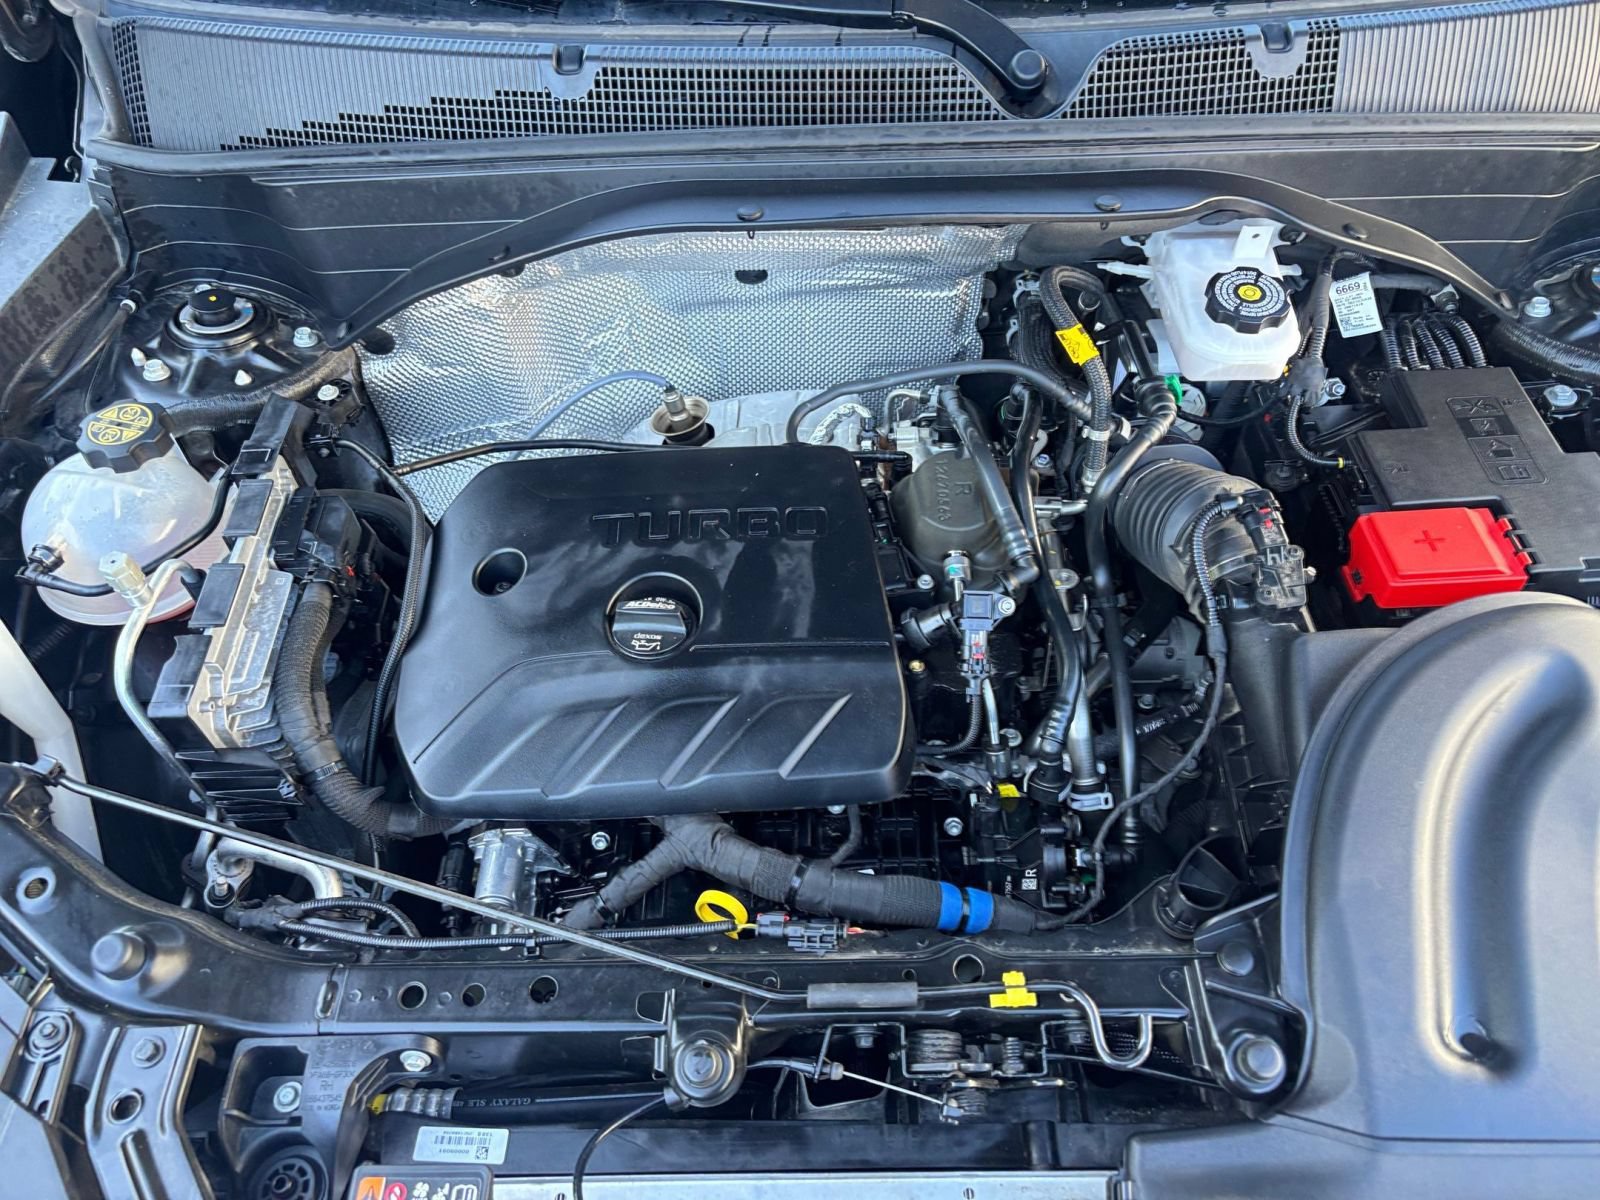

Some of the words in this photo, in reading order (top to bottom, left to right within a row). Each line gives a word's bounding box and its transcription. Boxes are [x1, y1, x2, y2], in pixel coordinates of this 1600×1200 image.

[1335, 282, 1361, 295] 6669
[954, 481, 973, 496] R
[592, 506, 829, 546] TURBO
[622, 601, 676, 610] ACDelco
[633, 632, 663, 640] dexos
[1025, 868, 1037, 877] R
[490, 1097, 532, 1107] GALAXY
